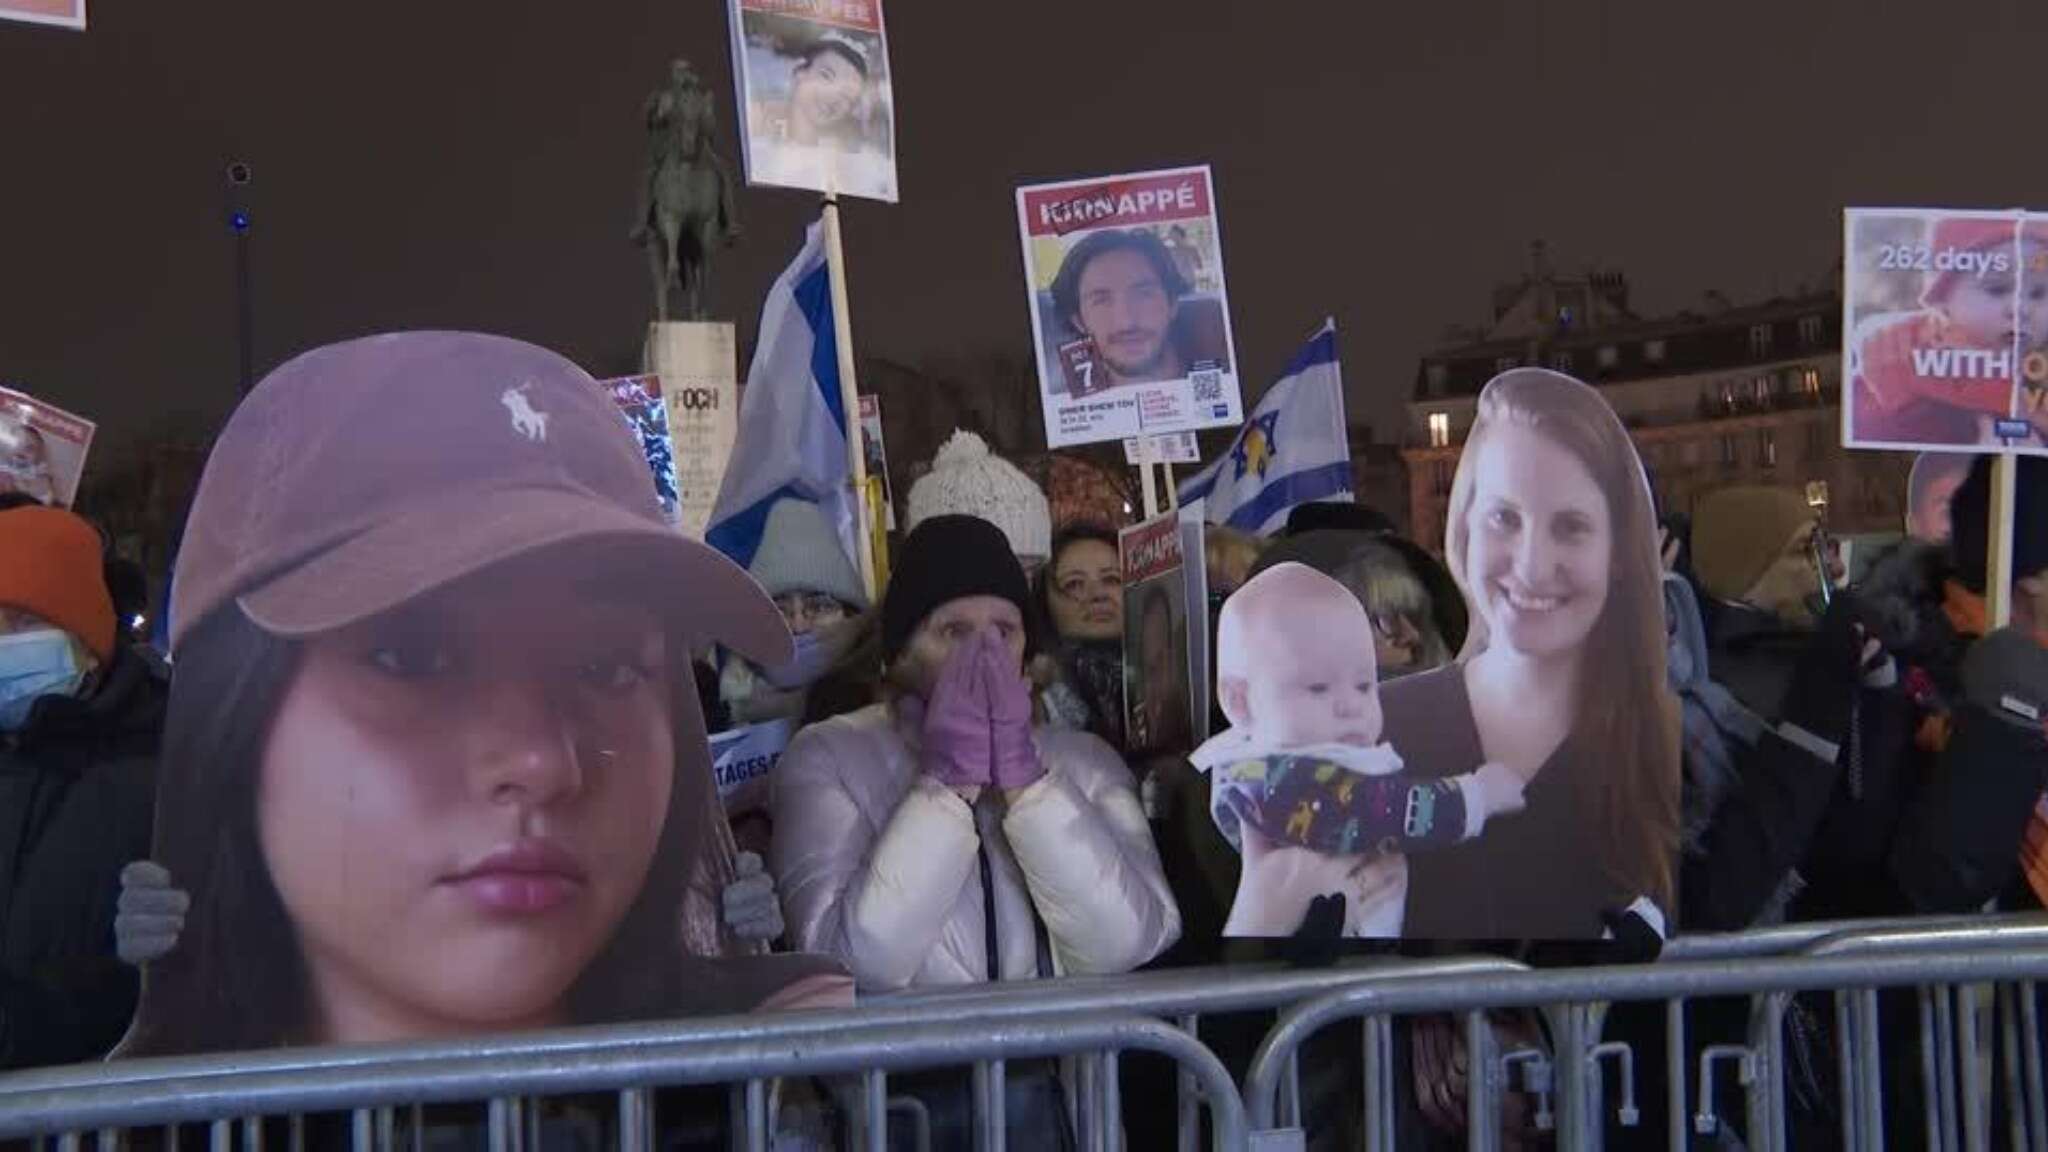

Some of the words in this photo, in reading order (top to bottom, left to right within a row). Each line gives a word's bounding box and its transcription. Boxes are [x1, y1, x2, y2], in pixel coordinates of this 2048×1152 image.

[1879, 245, 1933, 270] 262
[1935, 247, 2009, 279] days
[1074, 361, 1093, 388] 7
[1912, 348, 2010, 378] WITH
